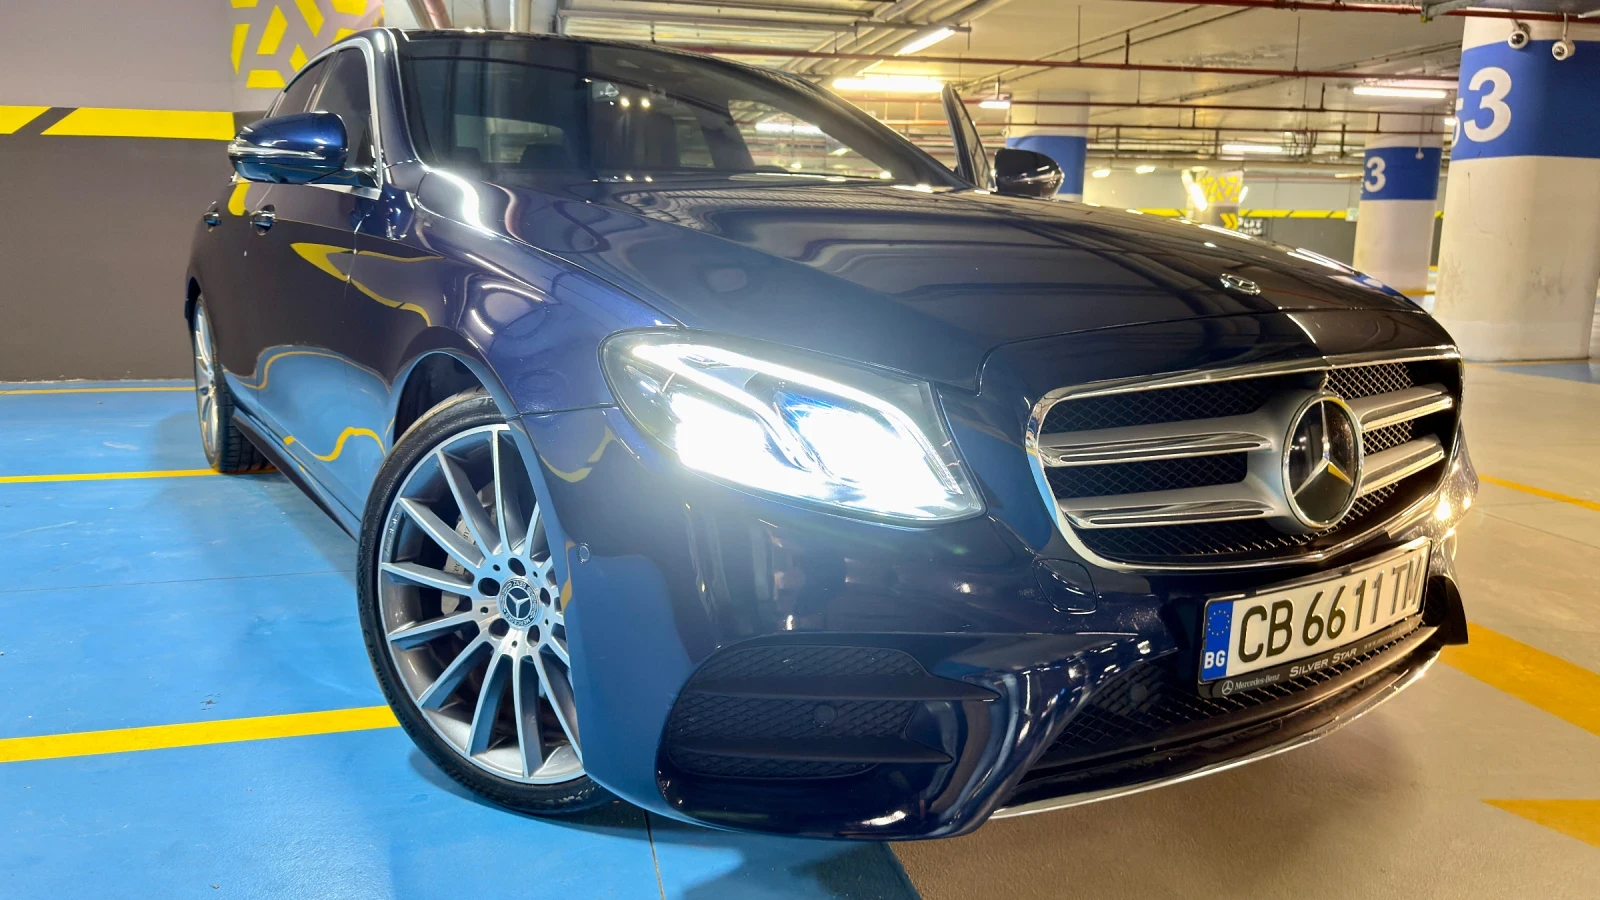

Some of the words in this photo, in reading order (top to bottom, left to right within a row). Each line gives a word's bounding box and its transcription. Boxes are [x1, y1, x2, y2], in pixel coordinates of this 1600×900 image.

[1238, 599, 1293, 663] CB
[1302, 570, 1384, 646] 6611
[1390, 553, 1424, 616] TM
[1204, 651, 1226, 669] BG
[1234, 673, 1281, 691] Mercedes-Benz
